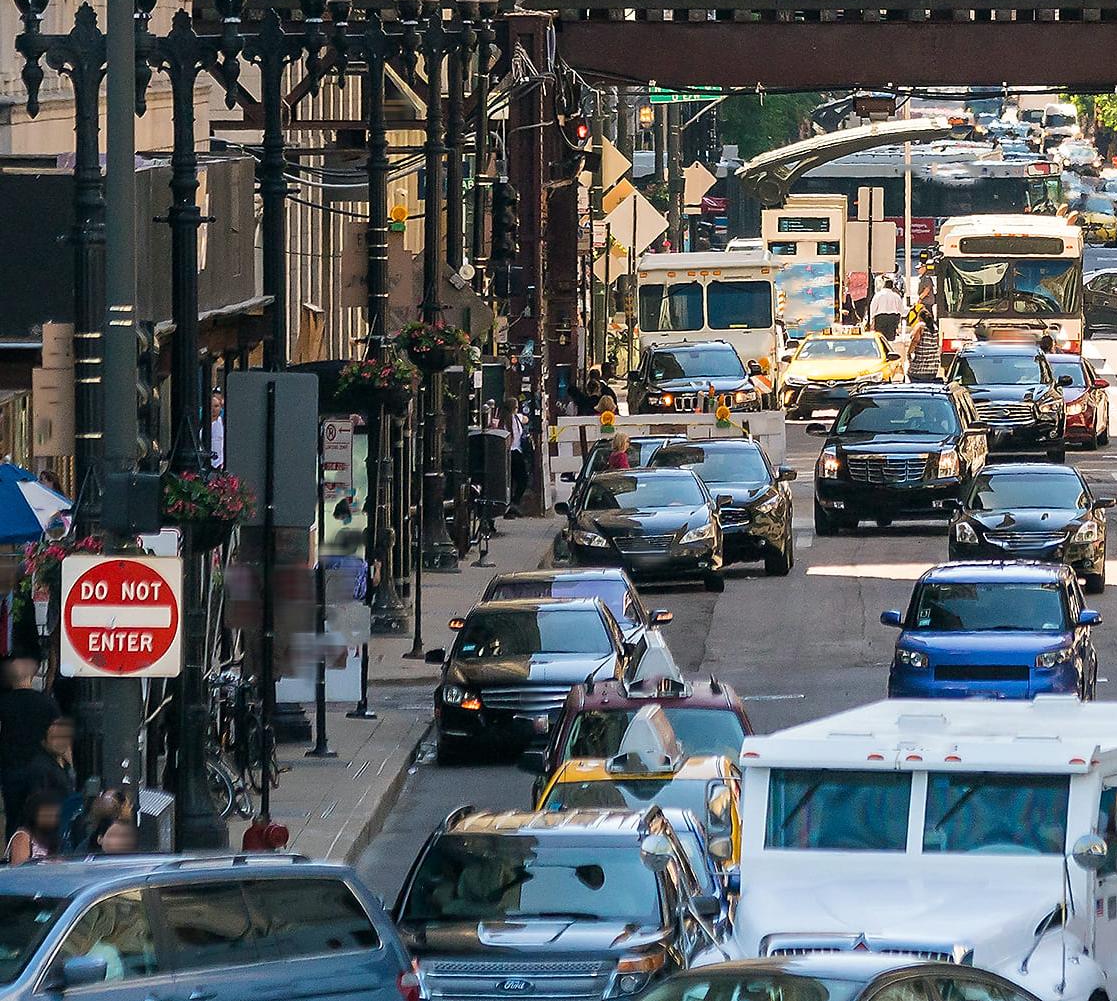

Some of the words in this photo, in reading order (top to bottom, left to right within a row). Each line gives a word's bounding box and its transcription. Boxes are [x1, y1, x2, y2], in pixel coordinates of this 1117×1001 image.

[81, 580, 108, 601] DO
[121, 580, 162, 602] NOT
[88, 631, 154, 653] ENTER
